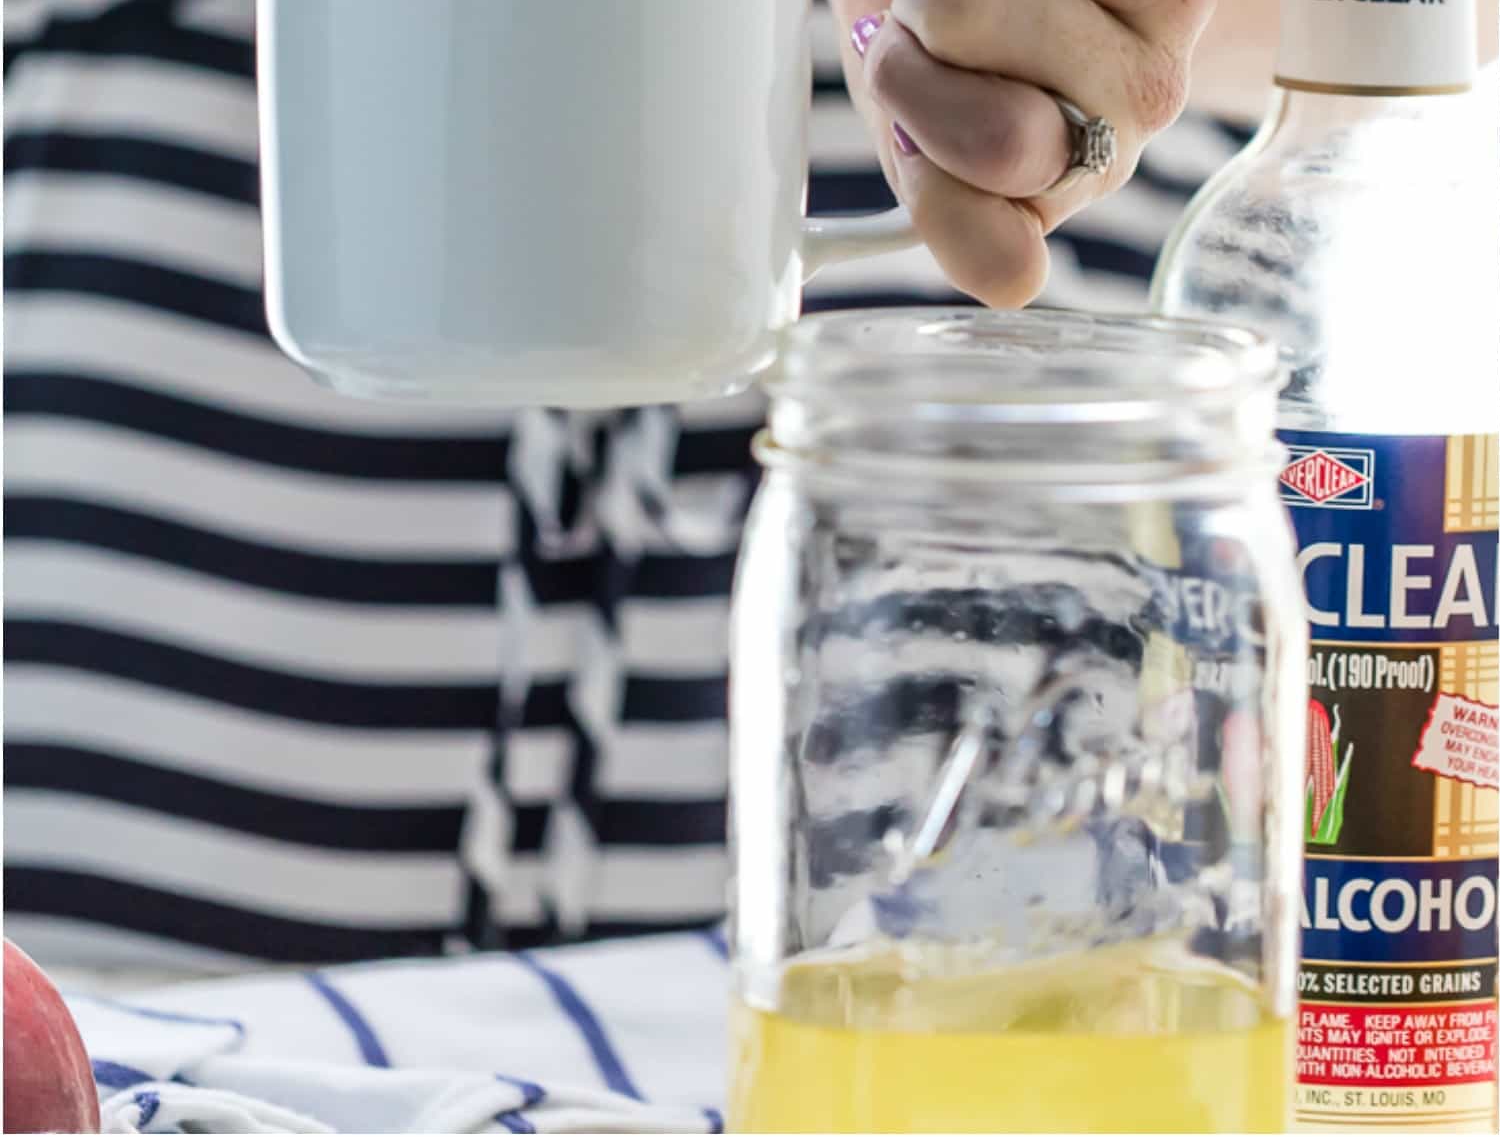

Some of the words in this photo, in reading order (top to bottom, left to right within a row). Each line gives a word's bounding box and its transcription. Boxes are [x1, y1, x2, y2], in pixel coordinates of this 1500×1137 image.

[1298, 543, 1499, 628] CLEA
[1375, 655, 1434, 692] Proof)
[1301, 876, 1499, 933] LCOHO
[1323, 974, 1413, 995] SELECTED
[1419, 972, 1481, 994] GRAINS
[1365, 1015, 1400, 1030] KEEP
[1403, 1014, 1447, 1029] AWAY
[1328, 1029, 1362, 1044] MAY
[1365, 1031, 1411, 1046] IGNITE
[1414, 1031, 1433, 1045] OR
[1388, 1049, 1417, 1063] NOT
[1332, 1063, 1442, 1079] NON-ALCOHOLIC
[1423, 1090, 1446, 1106] MO
